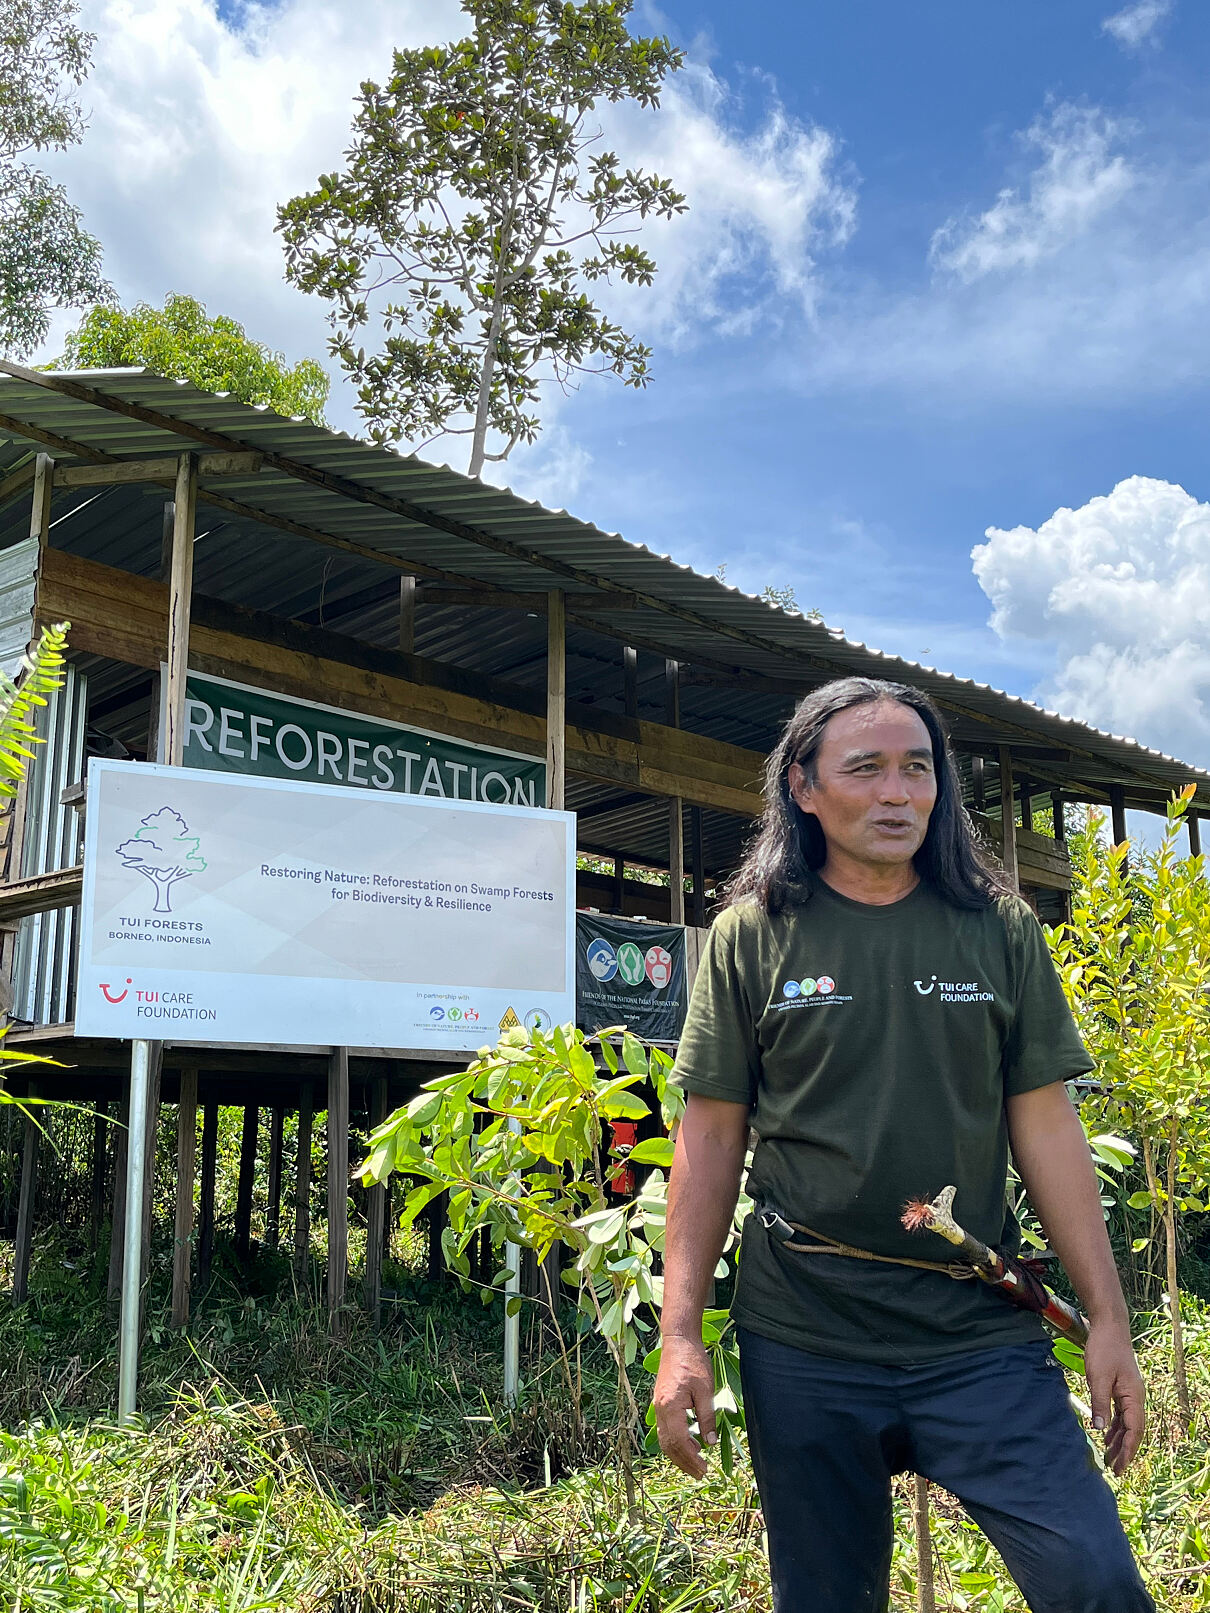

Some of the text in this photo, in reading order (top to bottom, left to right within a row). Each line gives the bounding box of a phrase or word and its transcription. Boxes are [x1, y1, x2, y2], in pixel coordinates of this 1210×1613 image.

[183, 698, 535, 807] REFORESTATION
[261, 864, 554, 901] Restoring Nature: Reforestation on Swamp Forests
[332, 888, 492, 912] for Biodiversity & Resilience
[120, 917, 204, 932] TUI FORESTS
[108, 932, 212, 945] BORNEO, INDONESIA
[938, 982, 978, 991] TUI CARE
[136, 990, 194, 1004] TUI CARE
[424, 993, 457, 1001] partnership
[940, 992, 994, 1002] FOUNDATION
[137, 1006, 216, 1020] FOUNDATION
